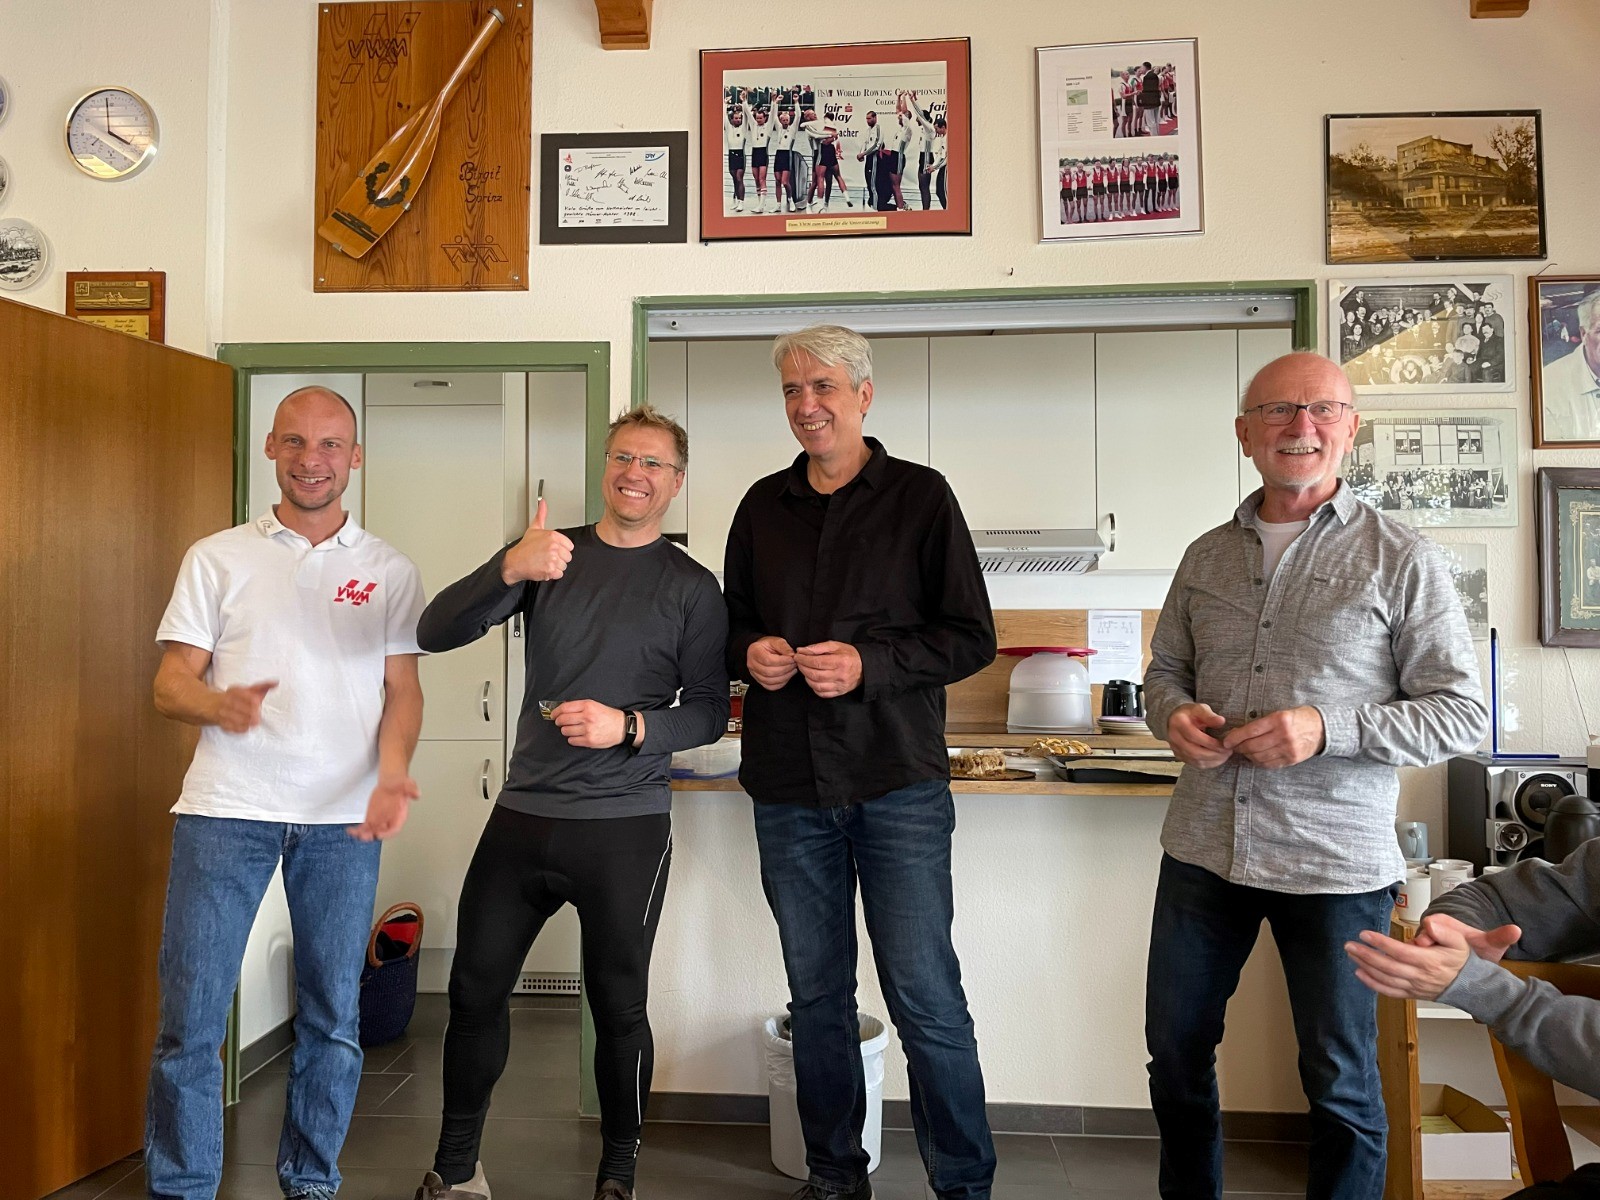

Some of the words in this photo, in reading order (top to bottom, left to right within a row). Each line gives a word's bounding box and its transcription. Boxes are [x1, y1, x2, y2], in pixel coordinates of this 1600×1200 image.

[836, 89, 861, 98] WORLD
[864, 88, 892, 97] ROWING
[824, 103, 842, 113] fair
[832, 113, 853, 123] lay
[838, 127, 859, 138] acher
[459, 161, 502, 183] Birgit
[464, 184, 503, 203] Sprinz
[338, 586, 369, 604] VWM
